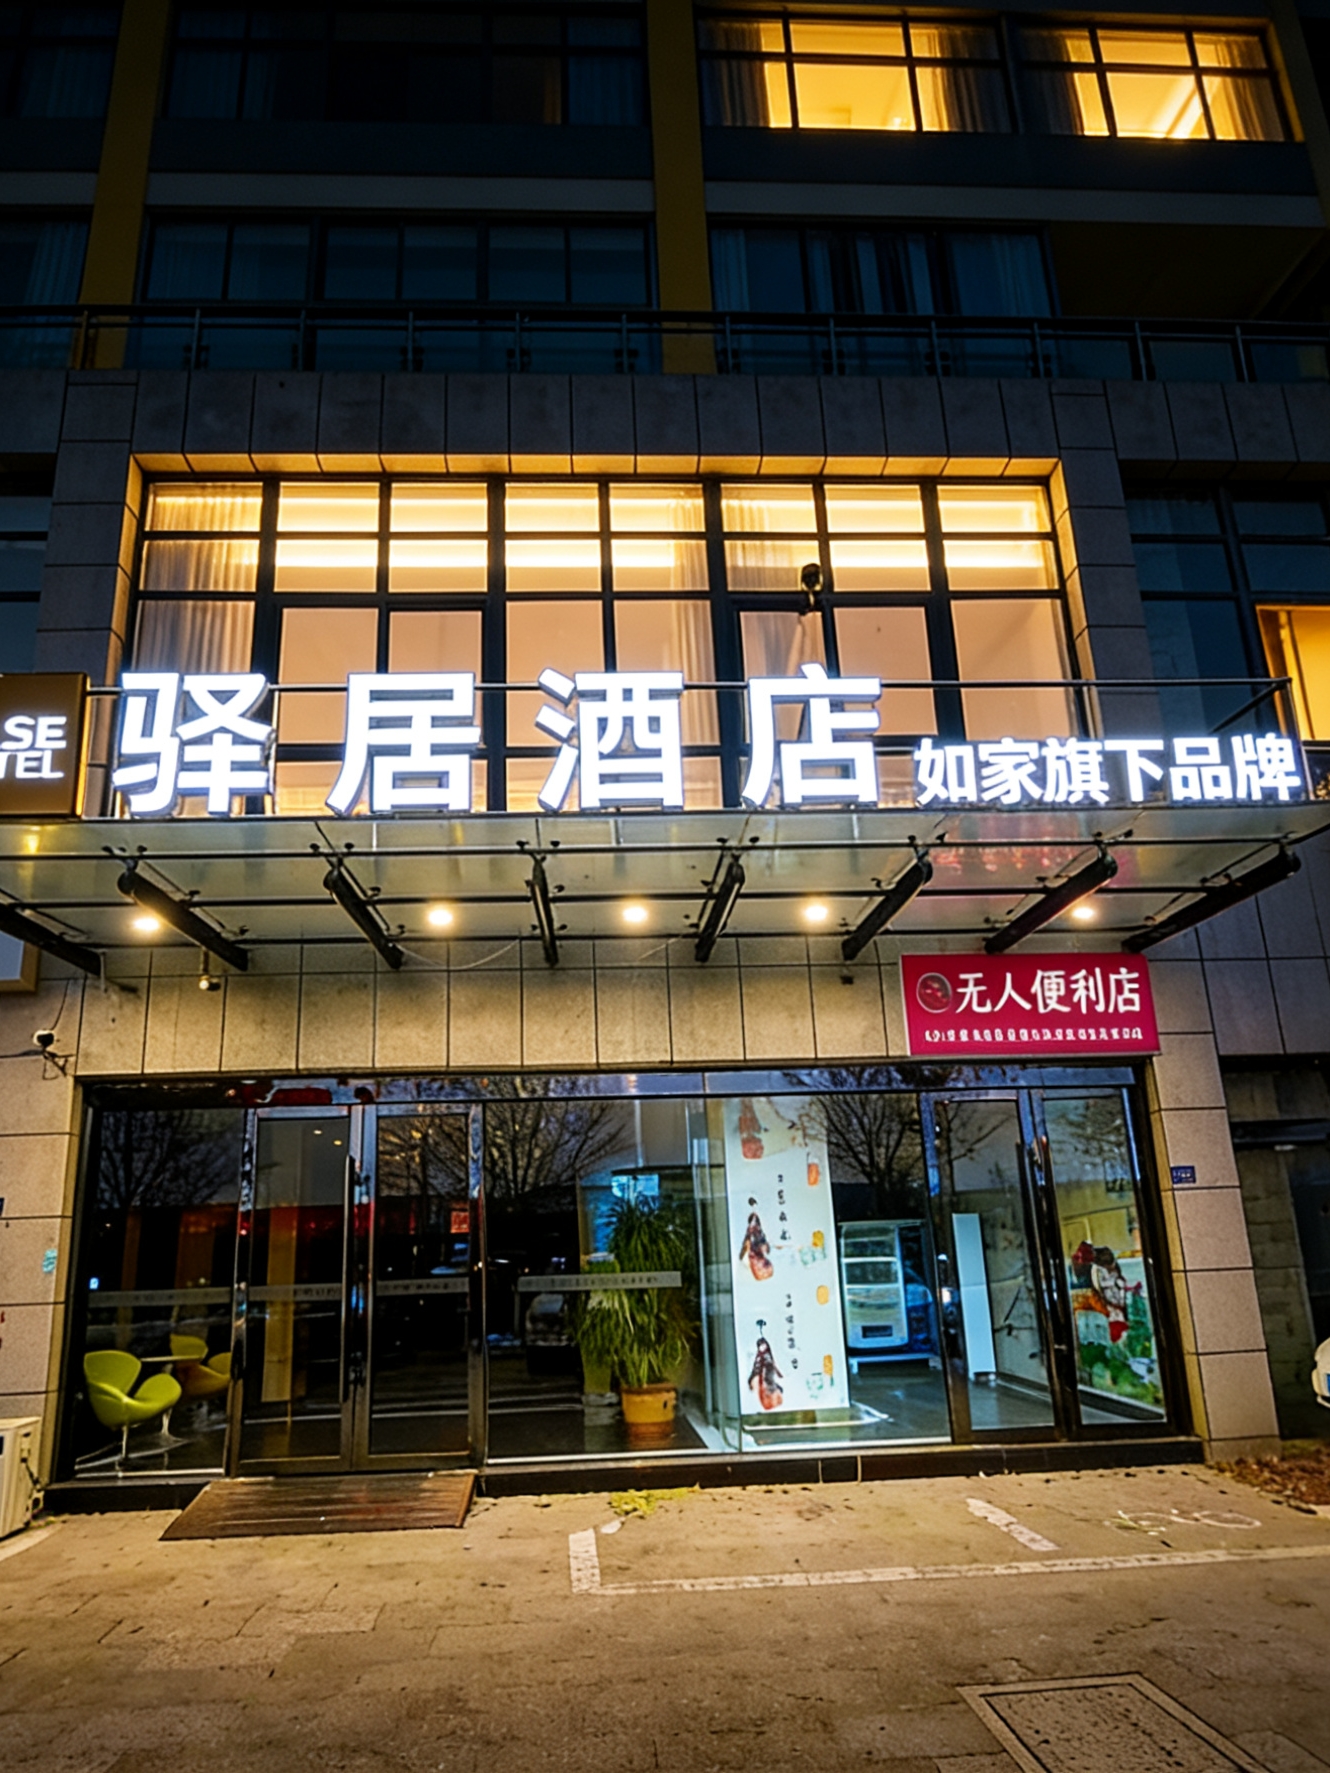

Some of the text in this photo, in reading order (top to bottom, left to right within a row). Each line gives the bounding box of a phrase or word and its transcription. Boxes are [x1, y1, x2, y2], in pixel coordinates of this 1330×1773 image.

[0, 715, 67, 750] SE
[112, 662, 881, 815] 驿居酒店
[913, 732, 1301, 806] 如家旗下品牌
[955, 967, 1141, 1014] 无人便利店
